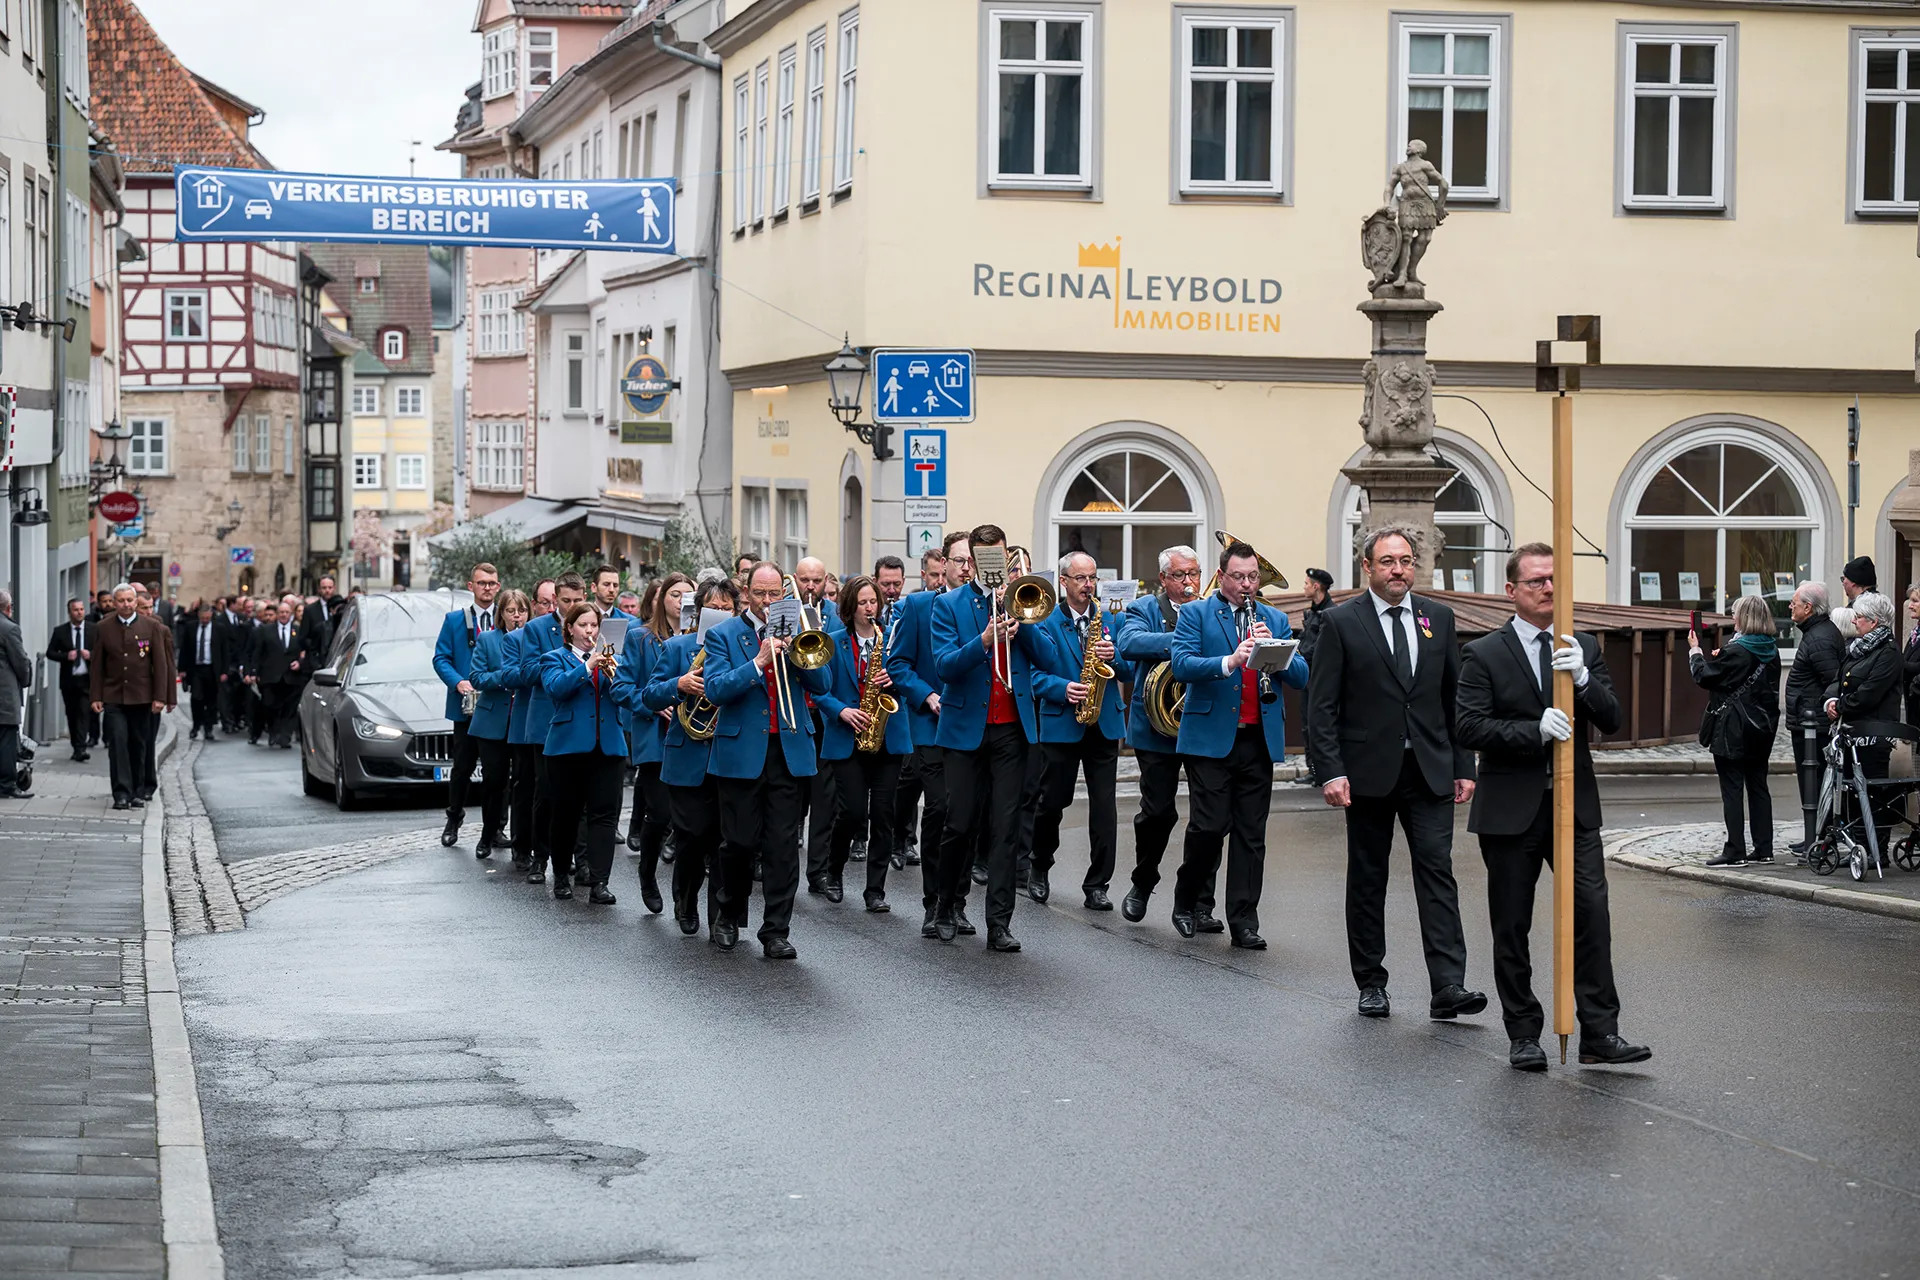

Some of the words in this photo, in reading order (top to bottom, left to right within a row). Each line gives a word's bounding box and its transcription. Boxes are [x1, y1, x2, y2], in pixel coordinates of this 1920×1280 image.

[268, 181, 589, 210] VERKEHRSBERUHIGTER
[372, 208, 490, 233] BEREICH
[974, 263, 1111, 300] REGINA
[1127, 268, 1282, 304] LEYBOLD
[626, 379, 668, 392] Tucher
